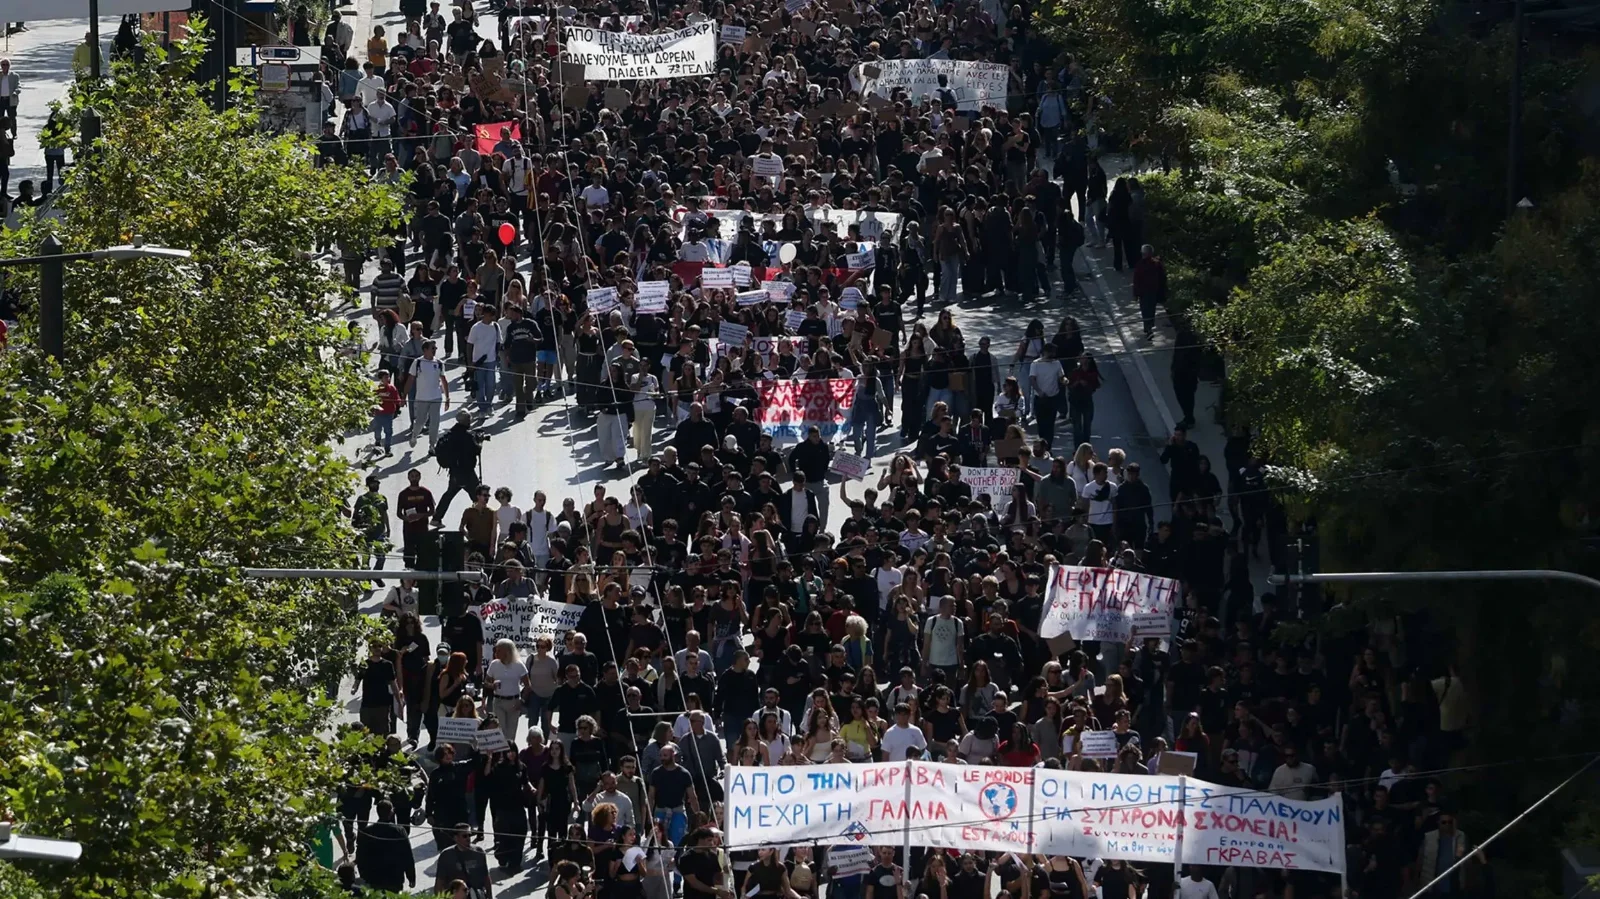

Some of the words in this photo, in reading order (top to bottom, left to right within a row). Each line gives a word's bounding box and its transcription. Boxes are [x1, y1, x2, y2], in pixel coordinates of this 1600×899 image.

[567, 27, 594, 42] ΑΠΟ
[674, 21, 715, 41] ΜΕΧΡΙ
[600, 44, 616, 55] ΤΗ
[655, 50, 695, 64] ΔΩΡΕΑΝ
[608, 65, 658, 78] ΠΑΙΔΕΙΑ
[682, 63, 704, 75] ΓΕΛ
[966, 71, 988, 80] AVEC
[992, 72, 1006, 81] LES
[989, 468, 1000, 477] BE
[1001, 468, 1019, 477] JUST
[963, 476, 997, 487] ANOTHER
[993, 486, 1013, 496] WALL
[730, 772, 796, 797] ΑΠΟ
[807, 771, 852, 791] ΤΗΝ
[862, 765, 946, 789] ΓΚΡΑΒΑ
[963, 769, 981, 783] LE
[984, 770, 1036, 786] MONDE
[1041, 778, 1068, 800] ΟΙ
[1091, 782, 1214, 809] ΜΑΘΗΤΕΣ
[1229, 795, 1341, 826] ΠΑΛΕΥΟΥΝ
[733, 803, 809, 830] ΜΕΧΡΙ
[817, 801, 852, 823] ΤΗ
[867, 799, 949, 821] ΓΑΛΛΙΑ
[1042, 805, 1073, 821] ΓΙΑ
[1081, 806, 1188, 830] ΣΥΓΧΡΟΝΑ
[1194, 810, 1298, 843] ΣΧΟΛΕΙΑ!
[962, 825, 990, 841] EST
[1207, 847, 1299, 869] ΓΚΡΑΒΑΣ
